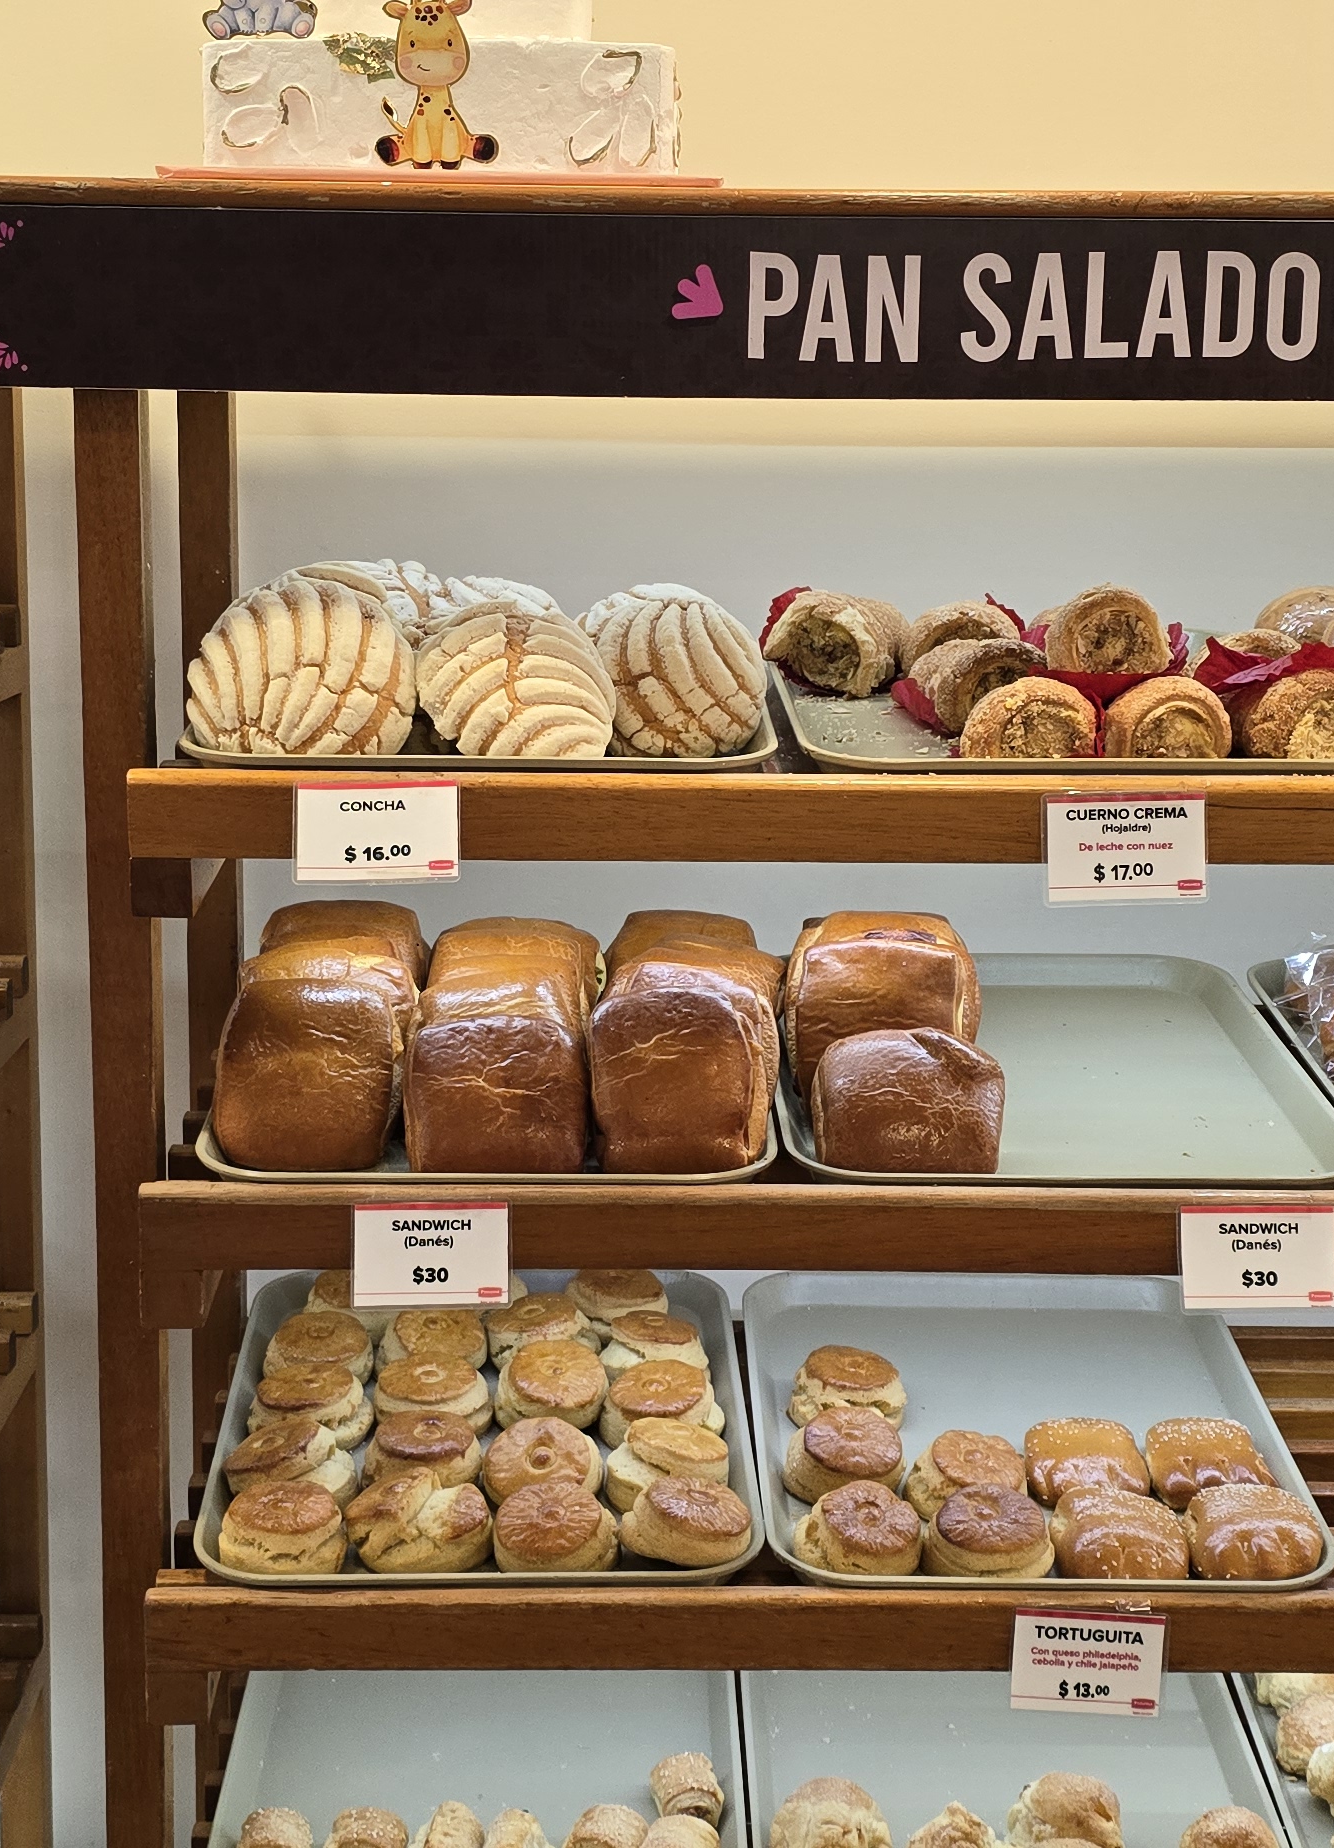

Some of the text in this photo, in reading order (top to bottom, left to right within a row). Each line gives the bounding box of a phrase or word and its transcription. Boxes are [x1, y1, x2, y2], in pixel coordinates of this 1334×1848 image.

[747, 251, 1321, 363] PAN SALADO
[339, 800, 406, 812] CONCHA
[1066, 806, 1188, 821] CUERNO CREMA
[1101, 823, 1152, 834] (Hojaldre)
[344, 844, 411, 863] $ 16.00
[1078, 842, 1174, 851] De leche con nuez
[1093, 862, 1154, 883] $ 17.00
[391, 1219, 472, 1232] SANDWICH
[1218, 1222, 1299, 1235] SANDWICH
[404, 1235, 454, 1249] (Danés)
[1231, 1238, 1282, 1252] (Danés)
[412, 1265, 449, 1285] $30
[1241, 1269, 1278, 1288] $30
[1034, 1625, 1144, 1645] TORTUGUITA
[1030, 1646, 1142, 1663] Con queso philadelphia,
[1031, 1656, 1065, 1667] cebolla
[1075, 1658, 1097, 1669] chile
[1098, 1660, 1139, 1672] jalapeño
[1058, 1679, 1110, 1699] $ 13.00
